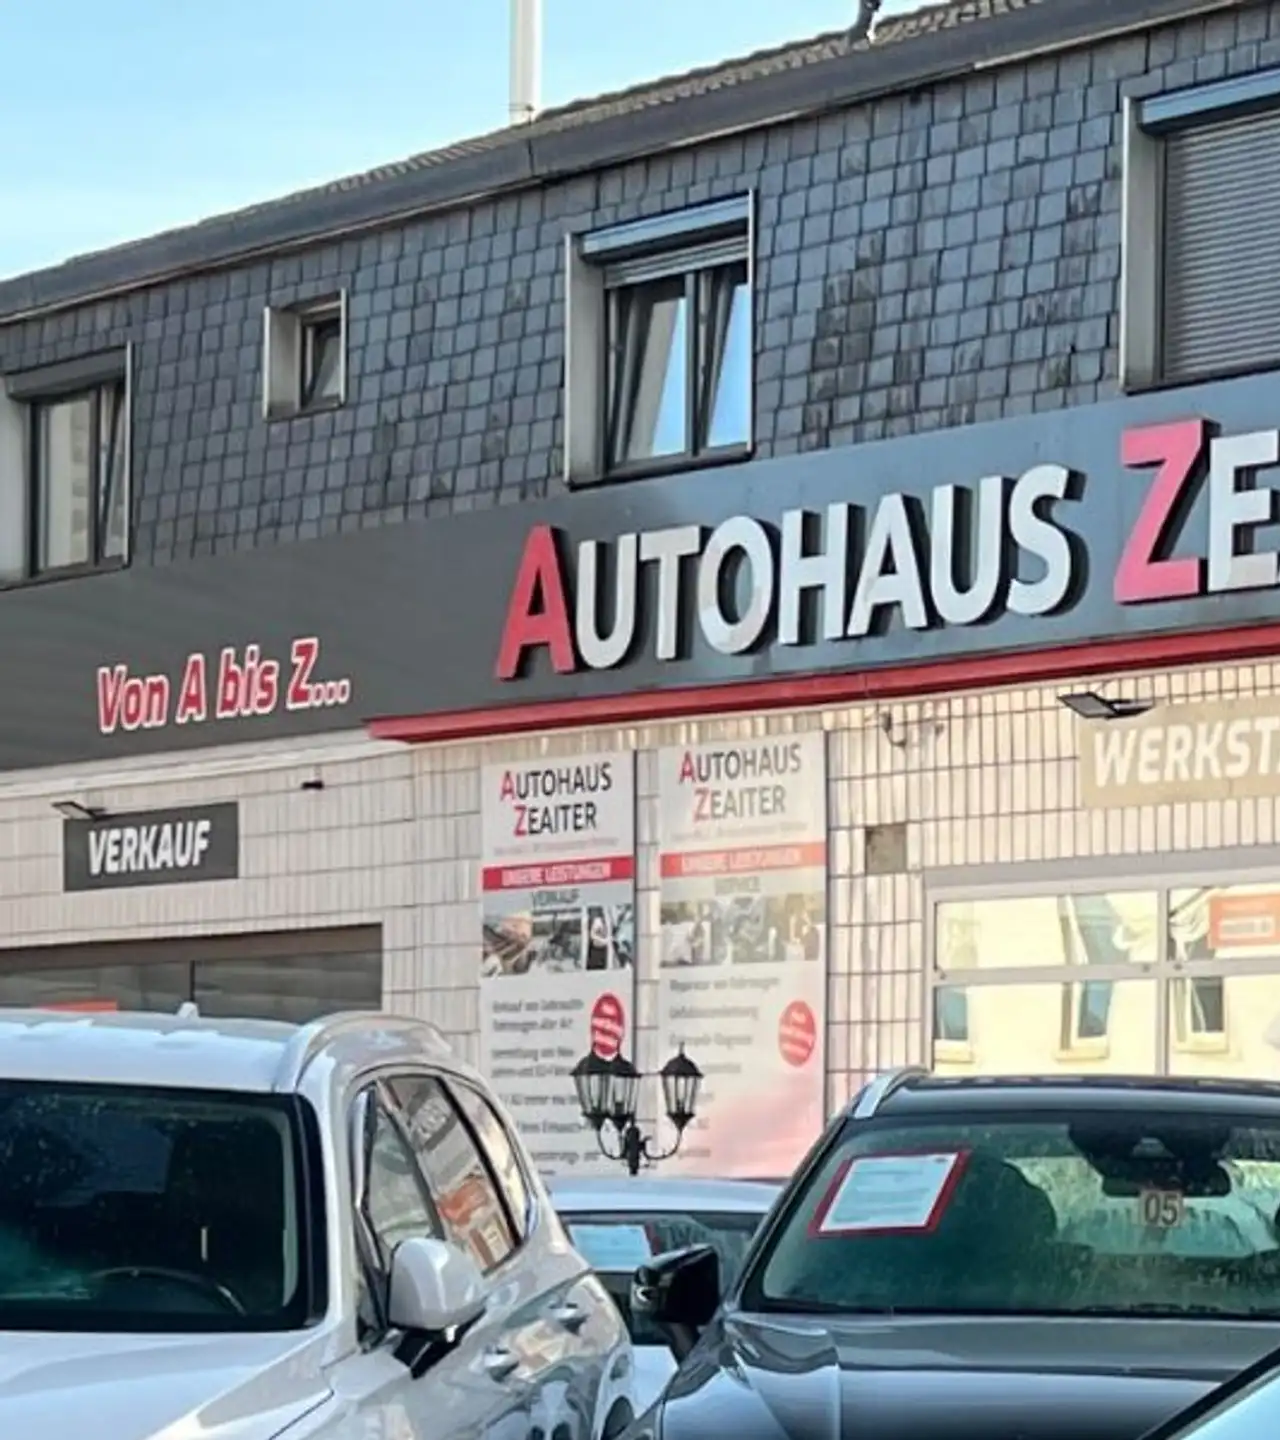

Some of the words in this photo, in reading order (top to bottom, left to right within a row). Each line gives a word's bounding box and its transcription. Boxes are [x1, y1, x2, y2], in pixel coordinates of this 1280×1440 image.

[495, 463, 1075, 682] AUTOHAUS
[97, 665, 169, 733] Von
[175, 653, 206, 724] A
[215, 644, 280, 720] bis
[500, 762, 612, 801] AUTOHAUS
[679, 743, 802, 785] AUTOHAUS
[513, 801, 598, 837] ZEAITER
[693, 784, 787, 823] ZEAITER
[88, 820, 211, 876] VERKAUF
[1144, 1193, 1178, 1226] 05
